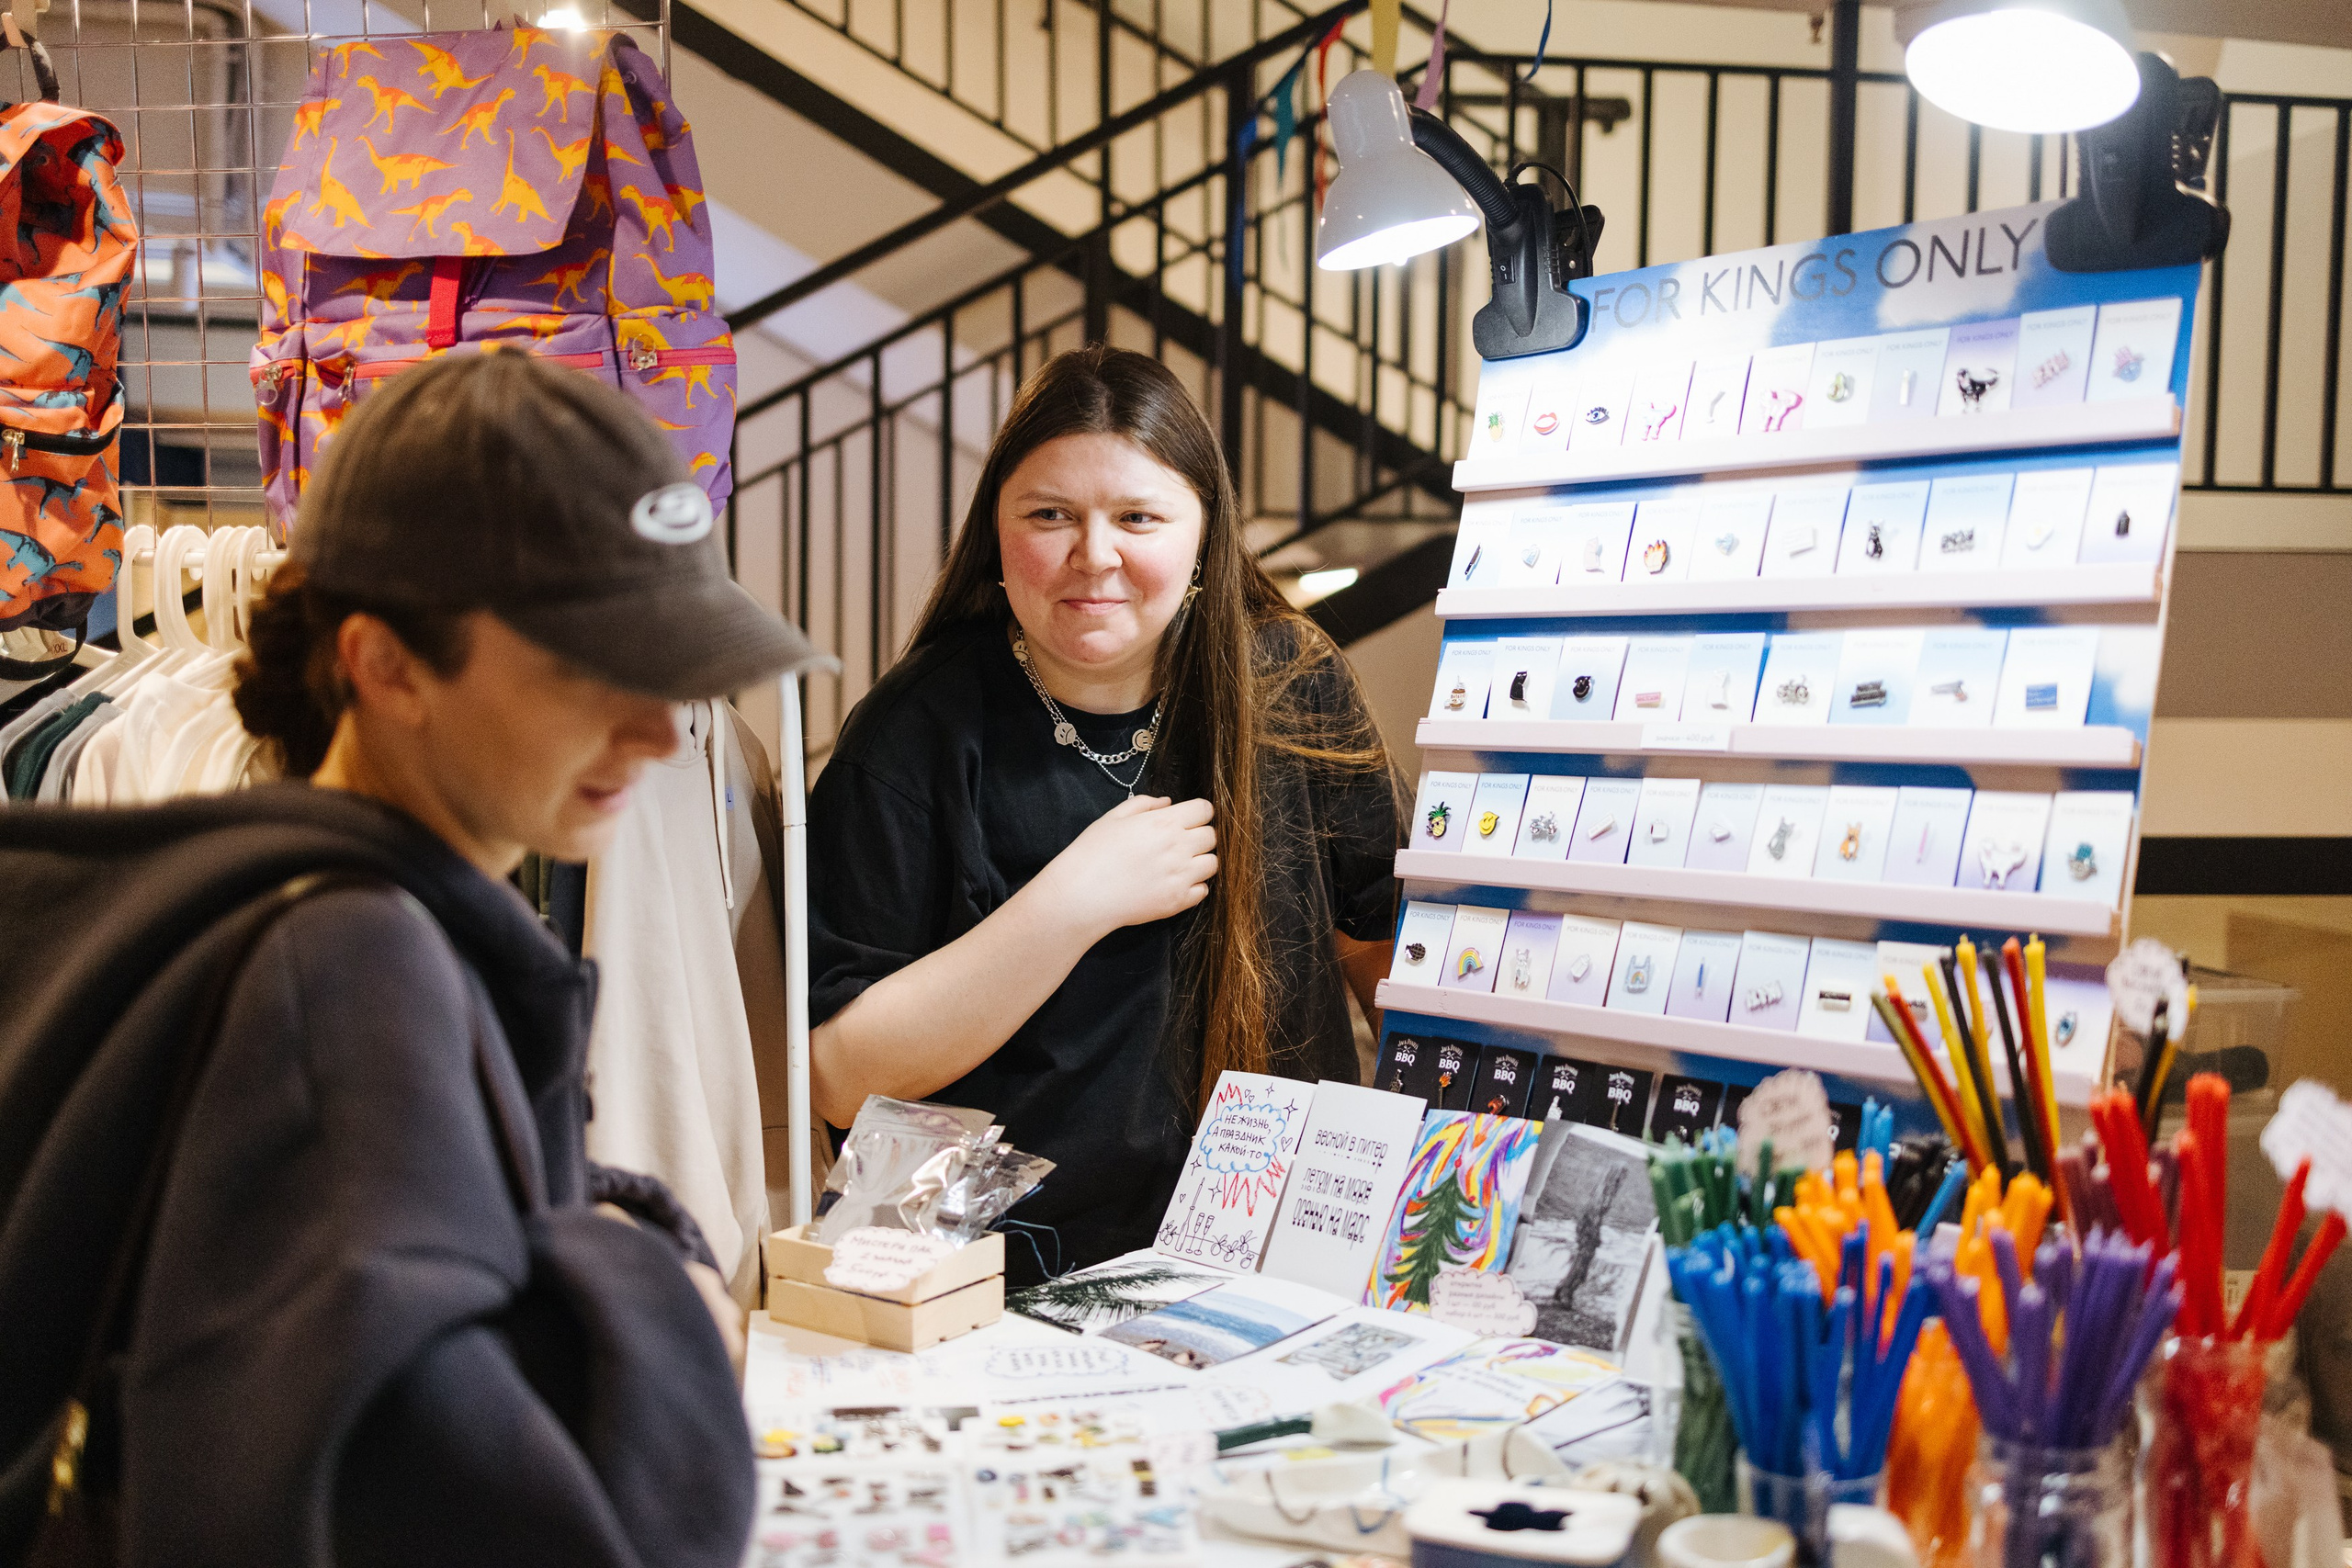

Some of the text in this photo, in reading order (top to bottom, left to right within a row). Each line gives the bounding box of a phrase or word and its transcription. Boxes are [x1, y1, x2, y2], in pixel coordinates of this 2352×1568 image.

[1591, 217, 2041, 333] FOR KINGS ONLY
[1395, 1052, 1416, 1066] BBQ
[1439, 1058, 1460, 1073] BBQ
[1493, 1069, 1516, 1084] BBQ
[1552, 1077, 1576, 1095] BBQ
[1608, 1088, 1632, 1104] BBQ
[1673, 1098, 1700, 1117] BBQ
[1220, 1129, 1267, 1145] ПРАЗДНИК
[1218, 1143, 1262, 1159] КАКОЙ-ТО
